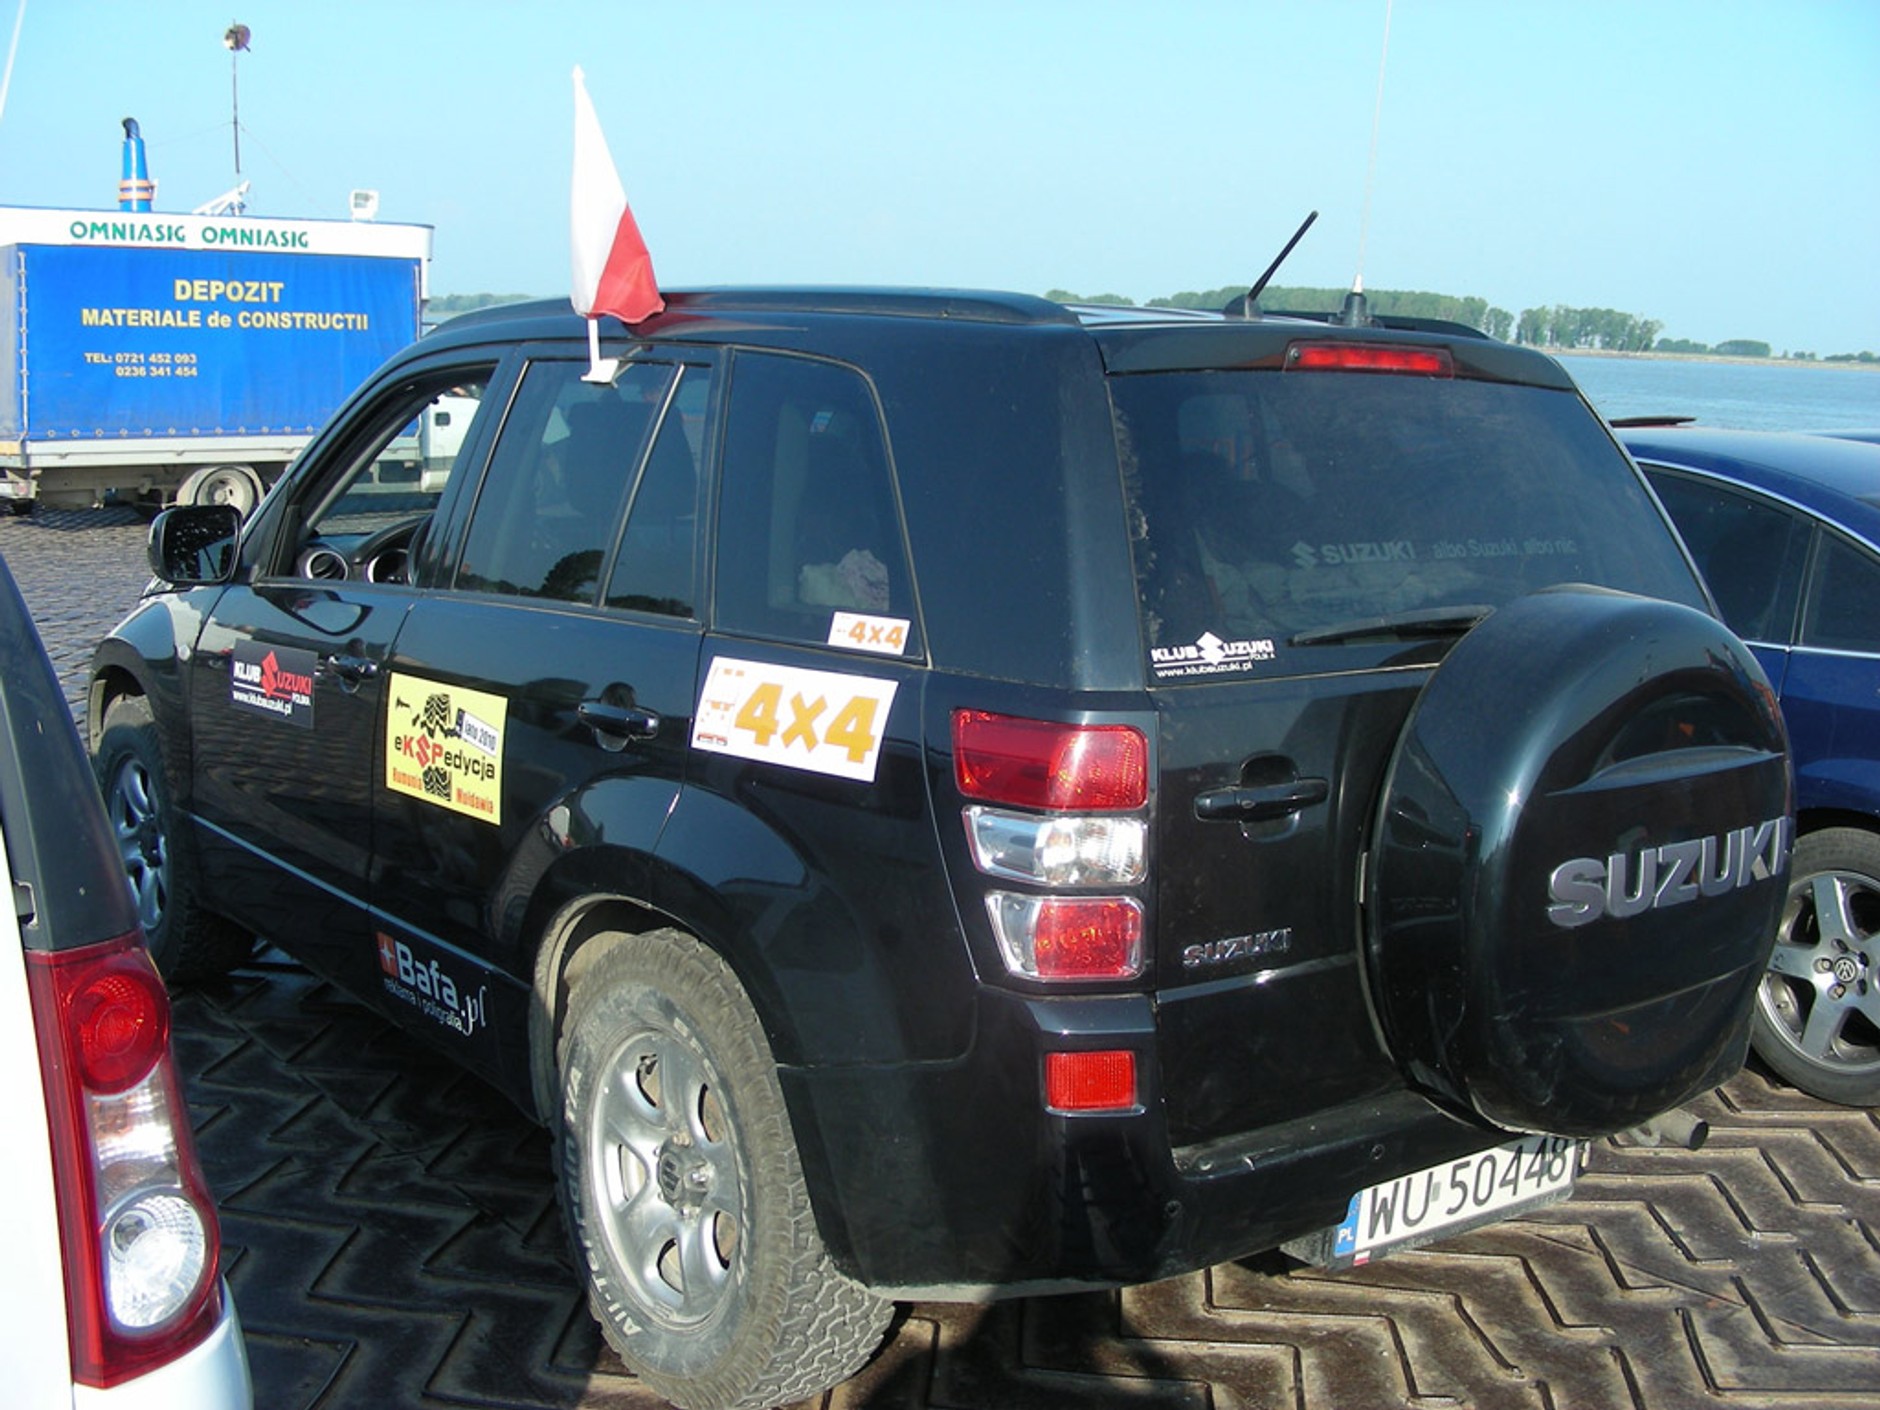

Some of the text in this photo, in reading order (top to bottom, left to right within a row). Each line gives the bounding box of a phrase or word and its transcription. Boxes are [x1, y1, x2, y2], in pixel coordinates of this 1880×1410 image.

[70, 221, 308, 248] OMNIASIG OMNIASIG
[174, 279, 284, 302] DEPOZIT
[82, 308, 368, 330] MATERIALE de CONSTRUCTII
[84, 352, 112, 363] TEL:
[115, 352, 145, 364] 0721
[1323, 541, 1417, 565] SUZUKI
[1151, 645, 1199, 661] KLUB
[233, 661, 262, 683] KLUB
[1546, 815, 1794, 929] SUZUKI
[1182, 927, 1292, 968] SUZUKI
[1368, 1171, 1434, 1240] WU
[1446, 1136, 1569, 1215] 50448
[1337, 1227, 1354, 1244] PL
